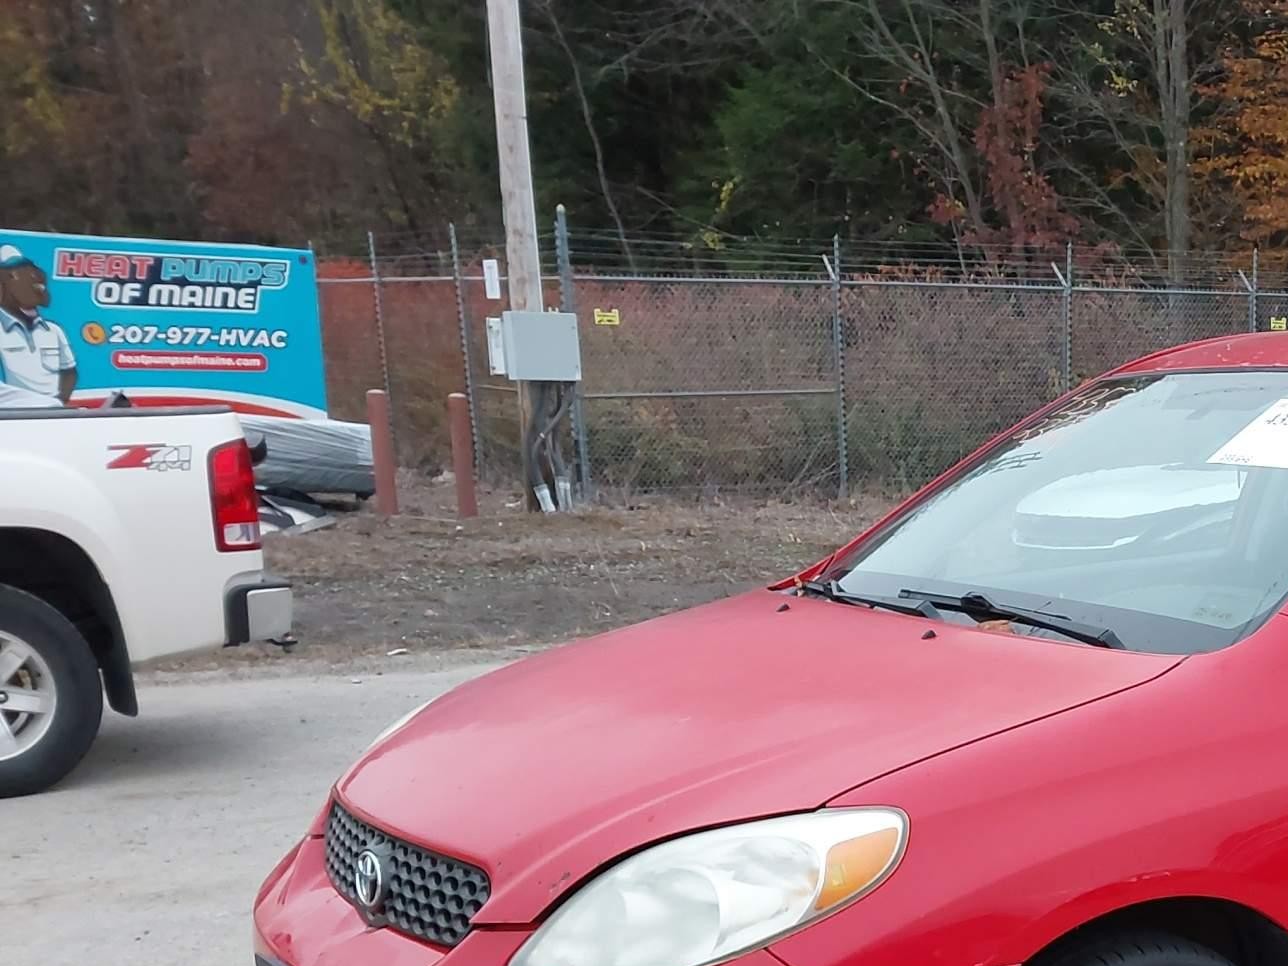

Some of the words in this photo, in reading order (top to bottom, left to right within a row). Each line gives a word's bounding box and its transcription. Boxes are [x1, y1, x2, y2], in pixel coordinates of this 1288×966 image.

[58, 252, 155, 279] HEAT
[160, 258, 286, 285] PUMPS
[97, 282, 142, 303] OF
[148, 284, 256, 309] MAINE
[109, 325, 288, 348] 207-977-HVAC
[118, 354, 261, 367] heatpumpsofmaine.com
